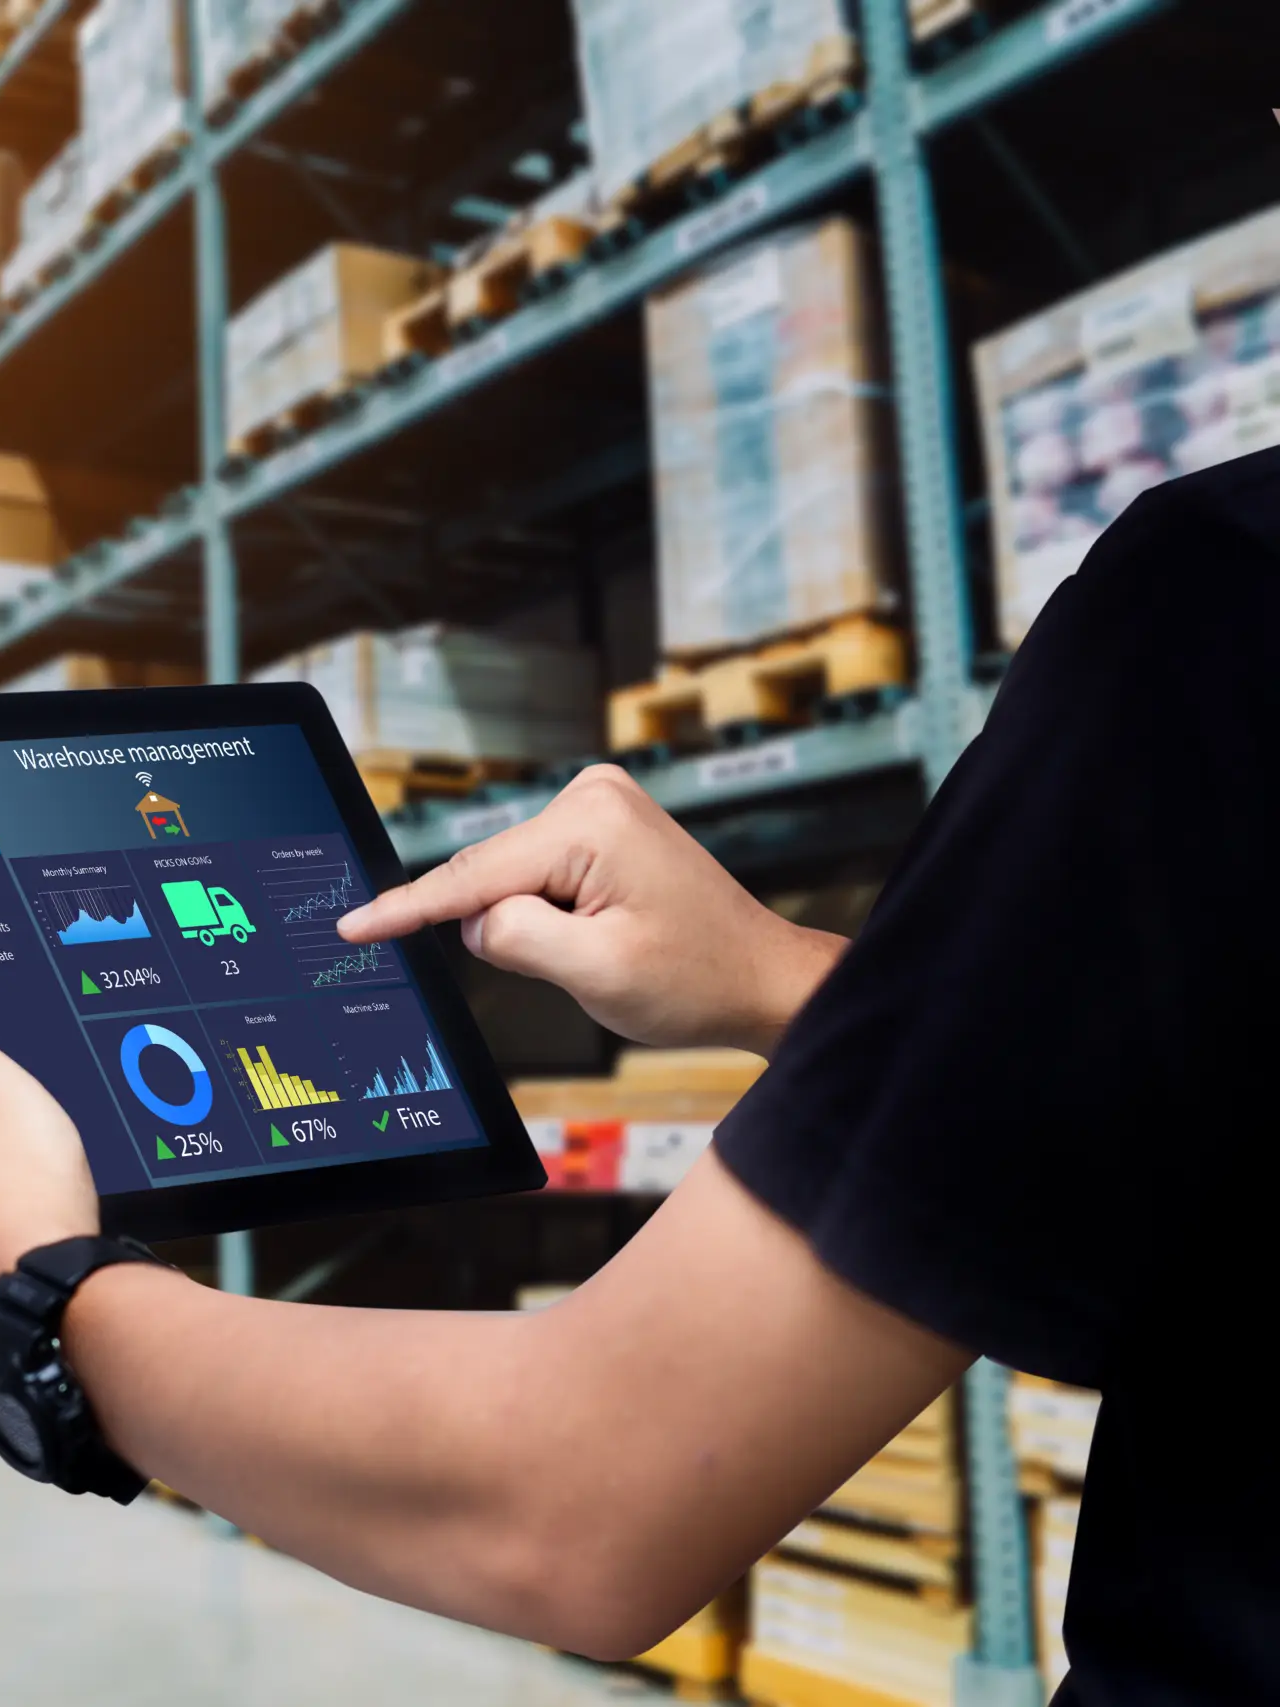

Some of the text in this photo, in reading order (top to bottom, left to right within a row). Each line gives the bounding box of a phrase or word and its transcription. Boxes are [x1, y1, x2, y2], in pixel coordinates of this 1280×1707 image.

[13, 737, 256, 770] Warehouse management
[271, 847, 324, 859] Orders by week
[154, 855, 212, 869] PICKS ON GOING
[42, 866, 107, 878] Monthly Summary
[221, 960, 240, 976] 23
[100, 967, 161, 989] 32.04%
[343, 1002, 390, 1014] Machine State
[245, 1013, 277, 1025] Receivals
[397, 1107, 442, 1130] Fine
[292, 1118, 337, 1142] 67%
[175, 1132, 223, 1157] 25%
